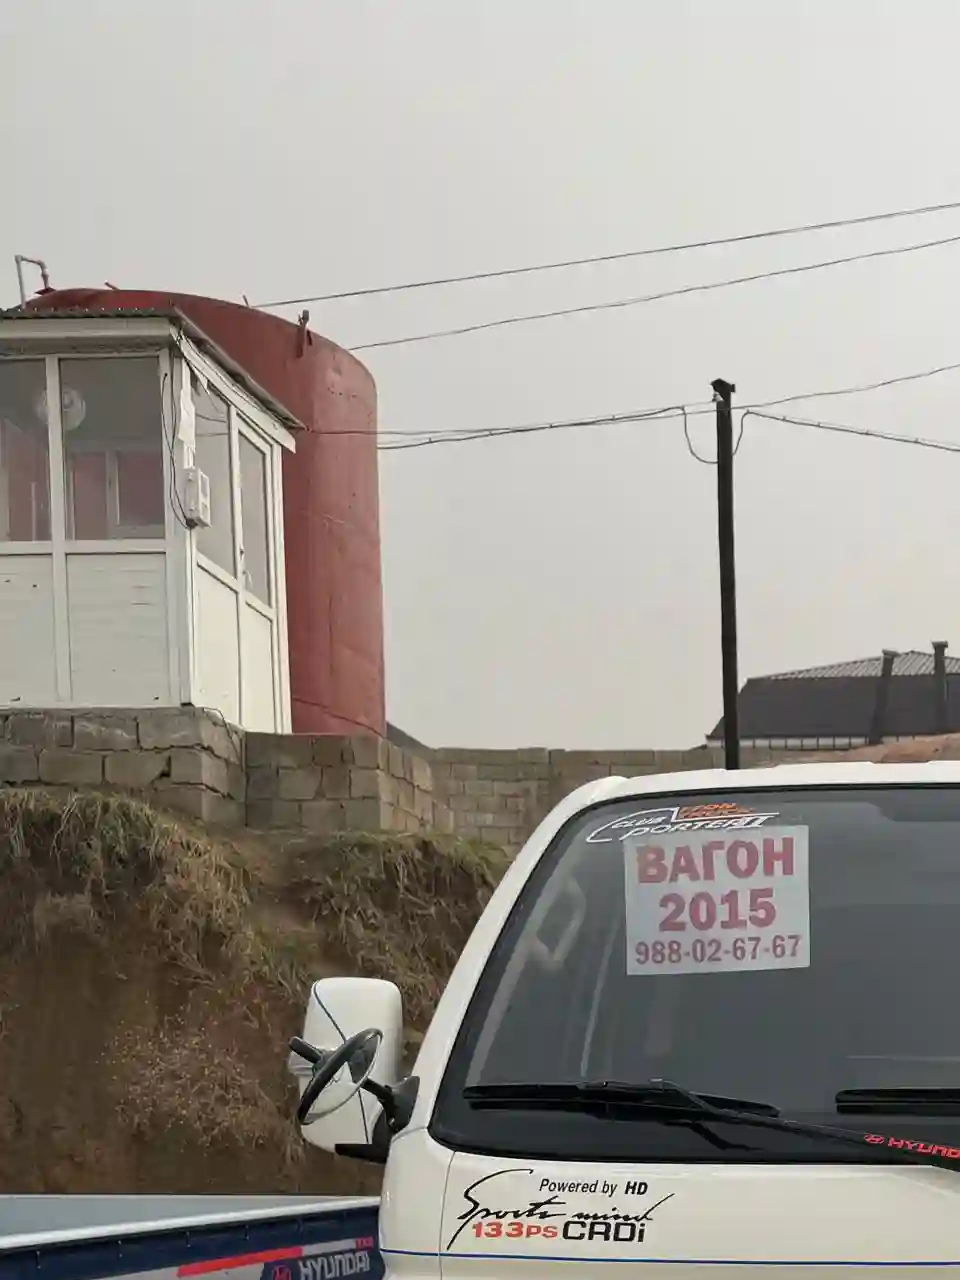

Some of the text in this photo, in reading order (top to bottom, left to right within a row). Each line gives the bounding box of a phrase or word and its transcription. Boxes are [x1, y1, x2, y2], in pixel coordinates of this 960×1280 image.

[636, 836, 795, 884] ВАГОН
[658, 887, 777, 932] 2015
[634, 934, 802, 965] 988-02-67-67
[538, 1178, 649, 1198] Powered by HD
[471, 1219, 646, 1243] 133PS CRDi
